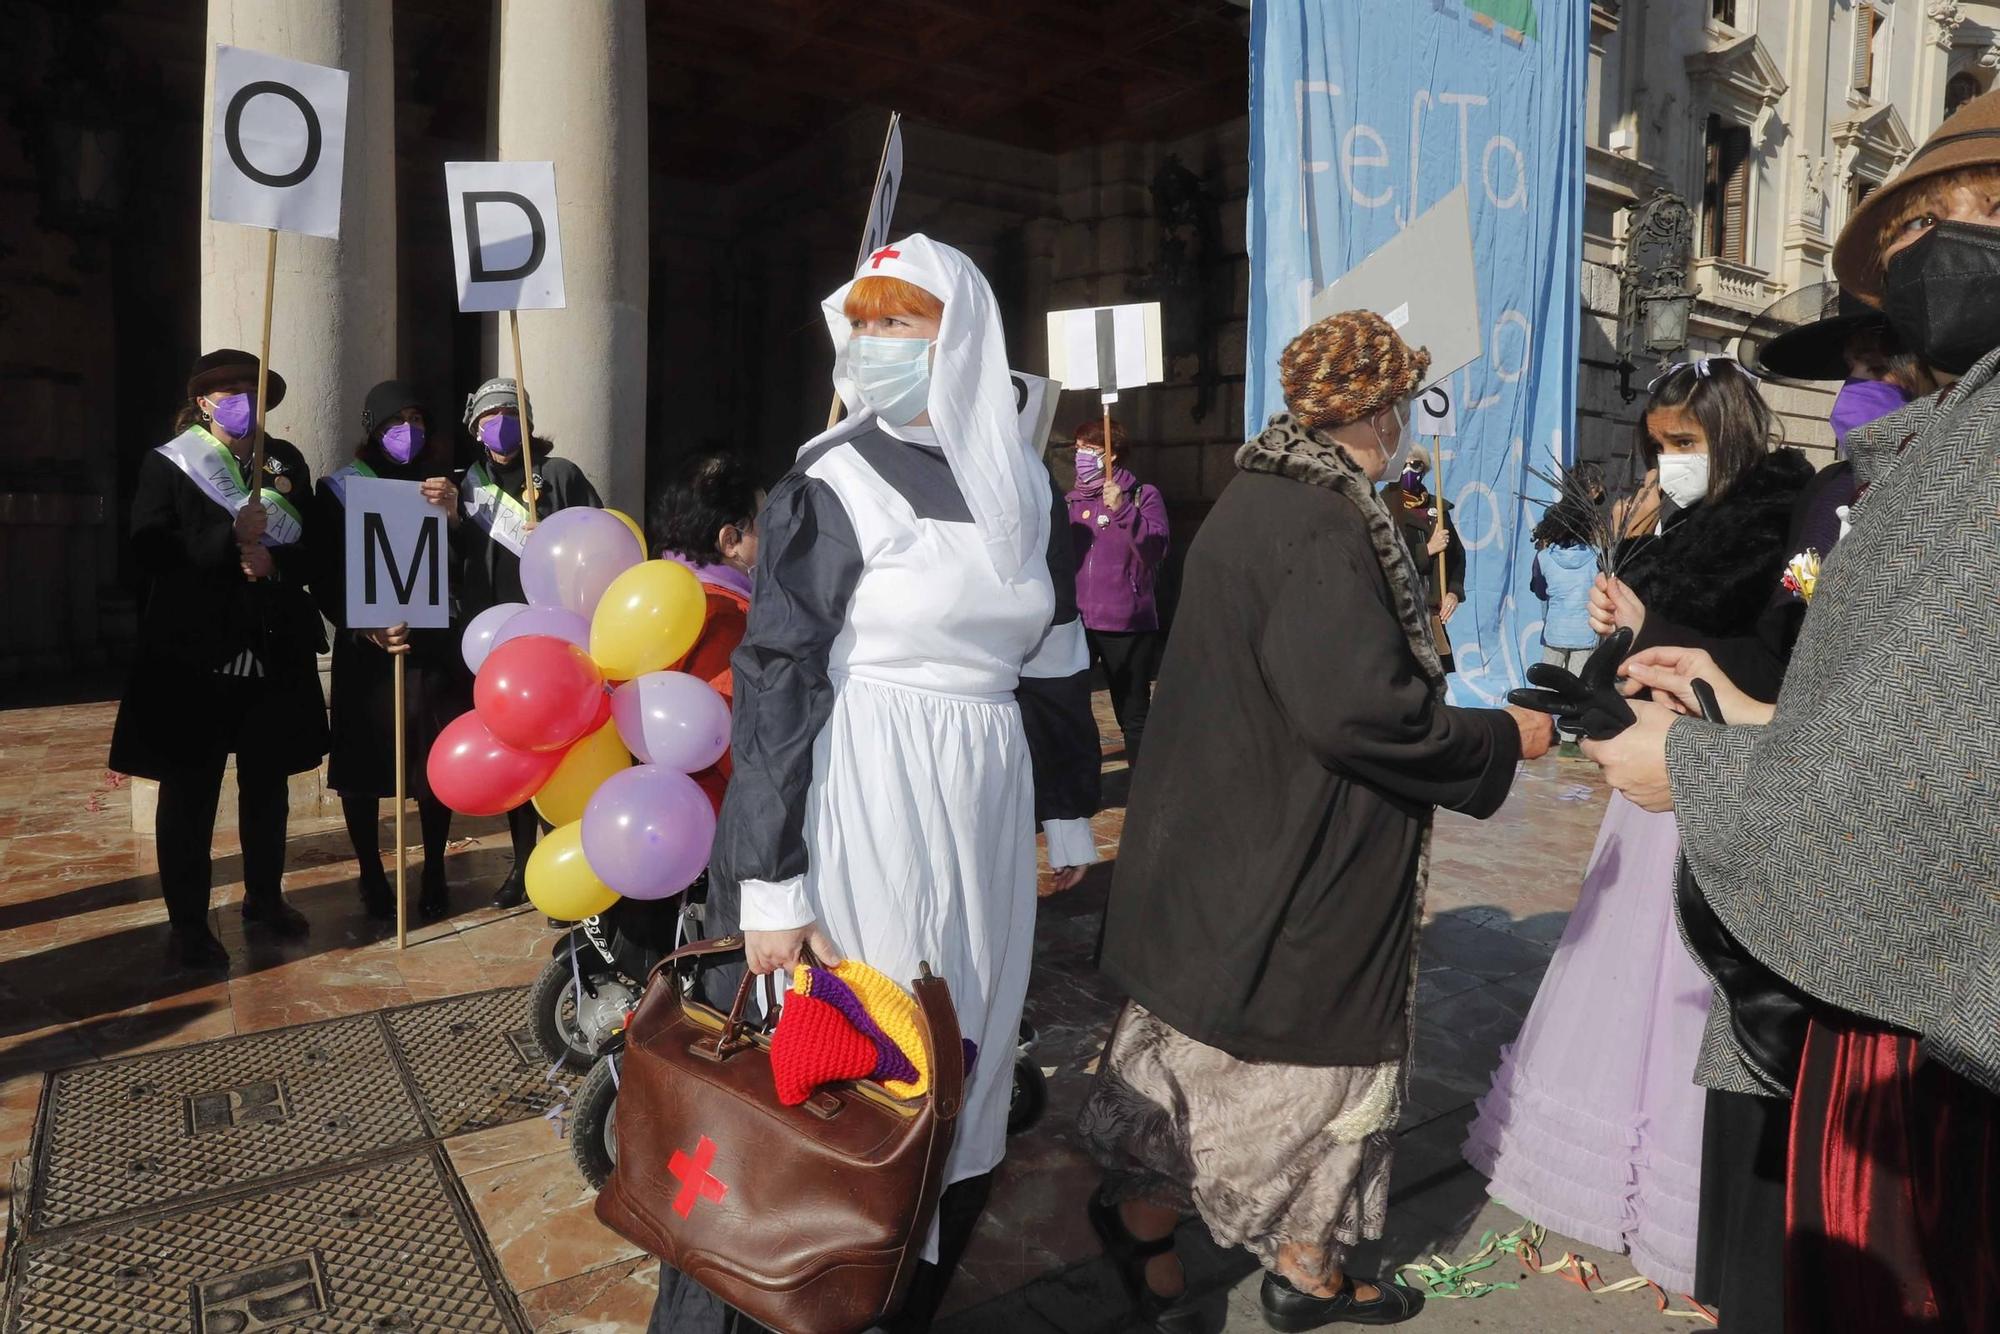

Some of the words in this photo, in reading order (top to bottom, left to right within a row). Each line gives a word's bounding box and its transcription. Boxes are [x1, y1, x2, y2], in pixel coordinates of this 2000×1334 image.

[224, 80, 322, 188] O
[462, 190, 546, 283] D
[363, 512, 440, 606] M
